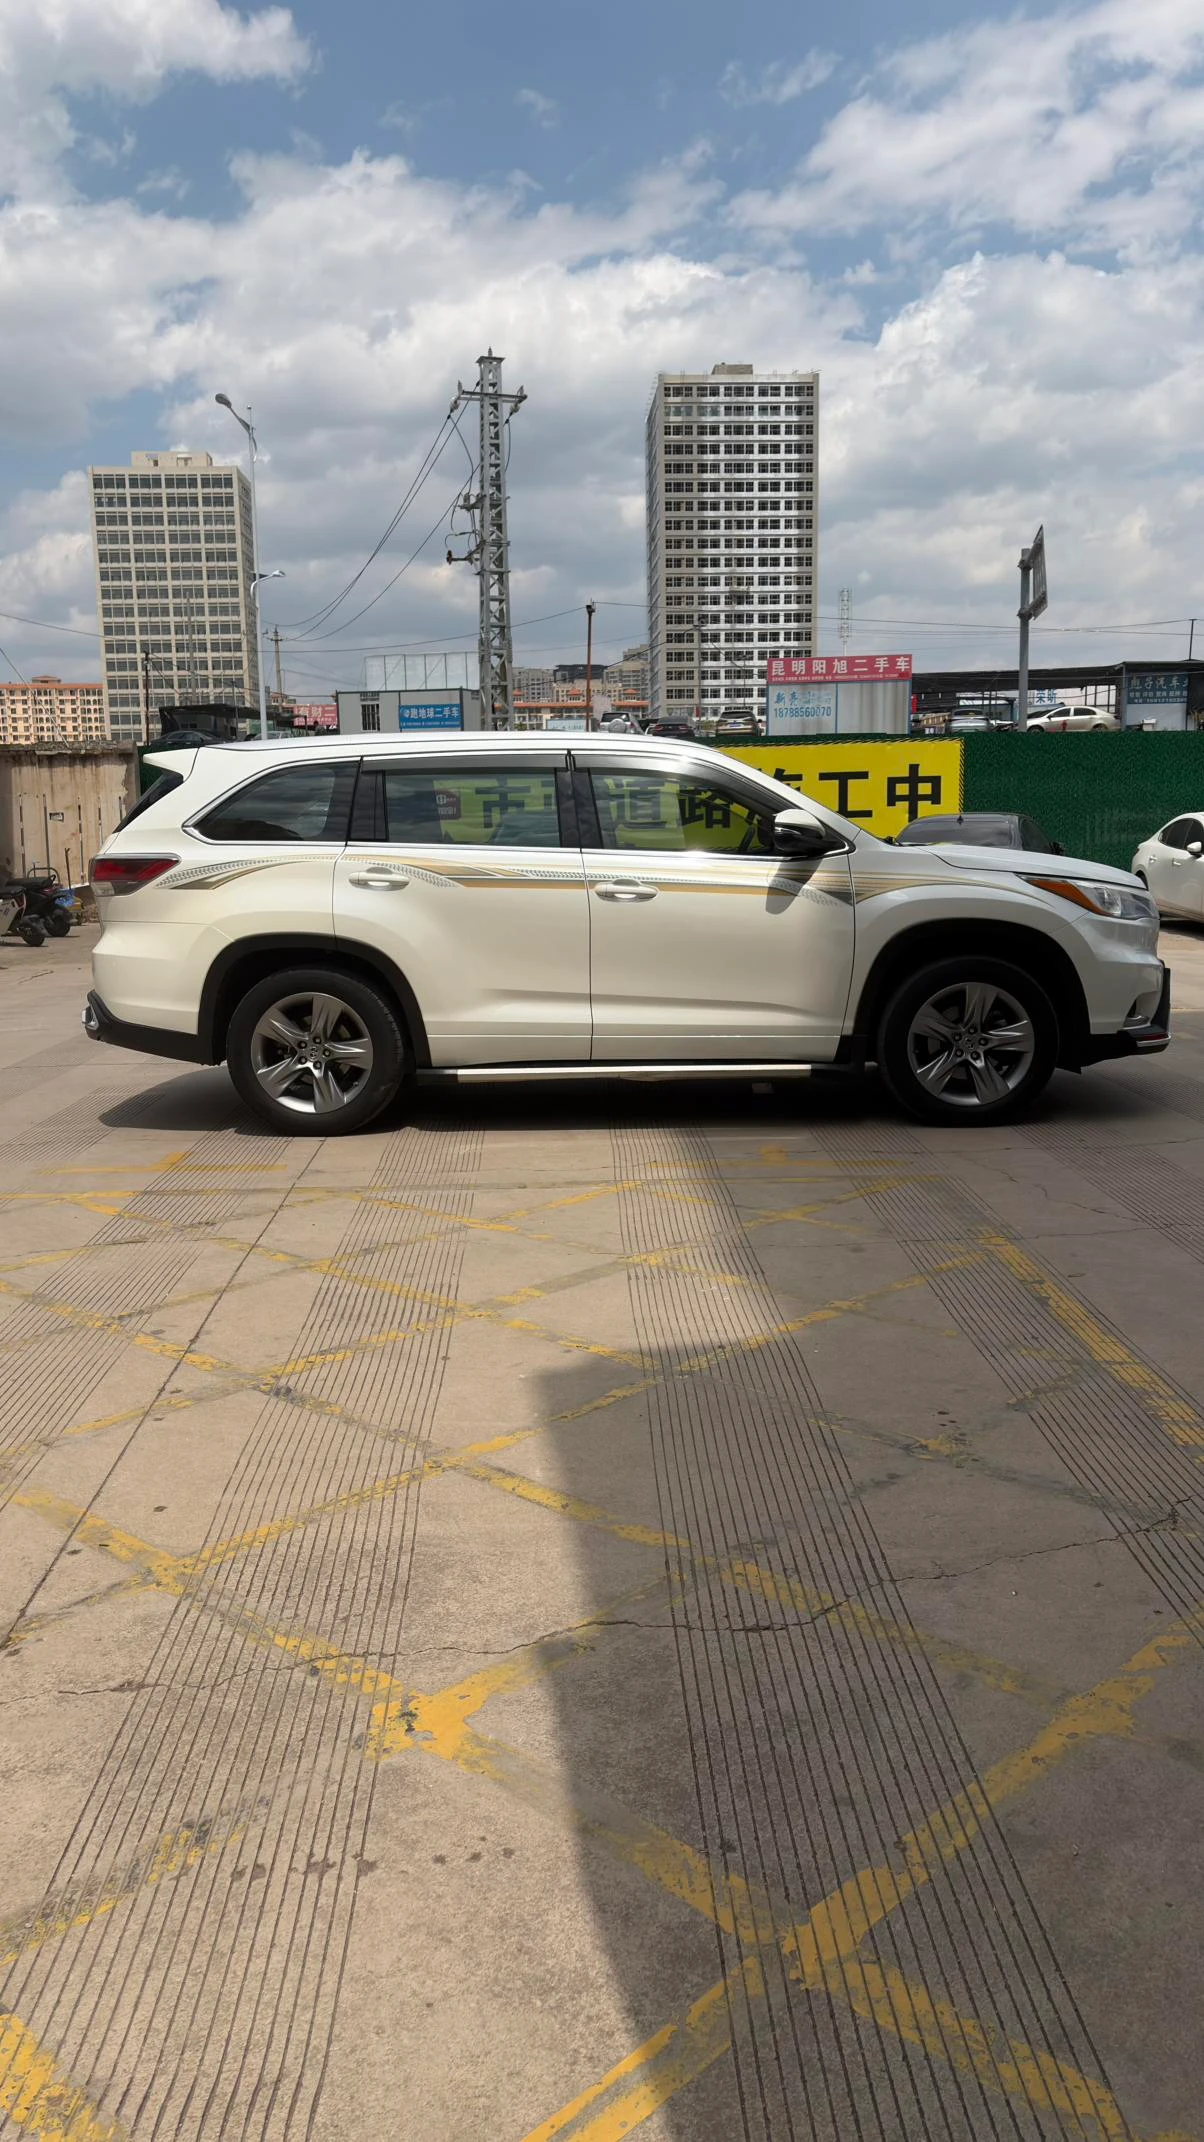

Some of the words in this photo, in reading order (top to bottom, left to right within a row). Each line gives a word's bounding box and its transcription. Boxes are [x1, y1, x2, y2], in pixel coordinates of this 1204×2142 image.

[771, 656, 910, 676] 昆明阳旭二手车
